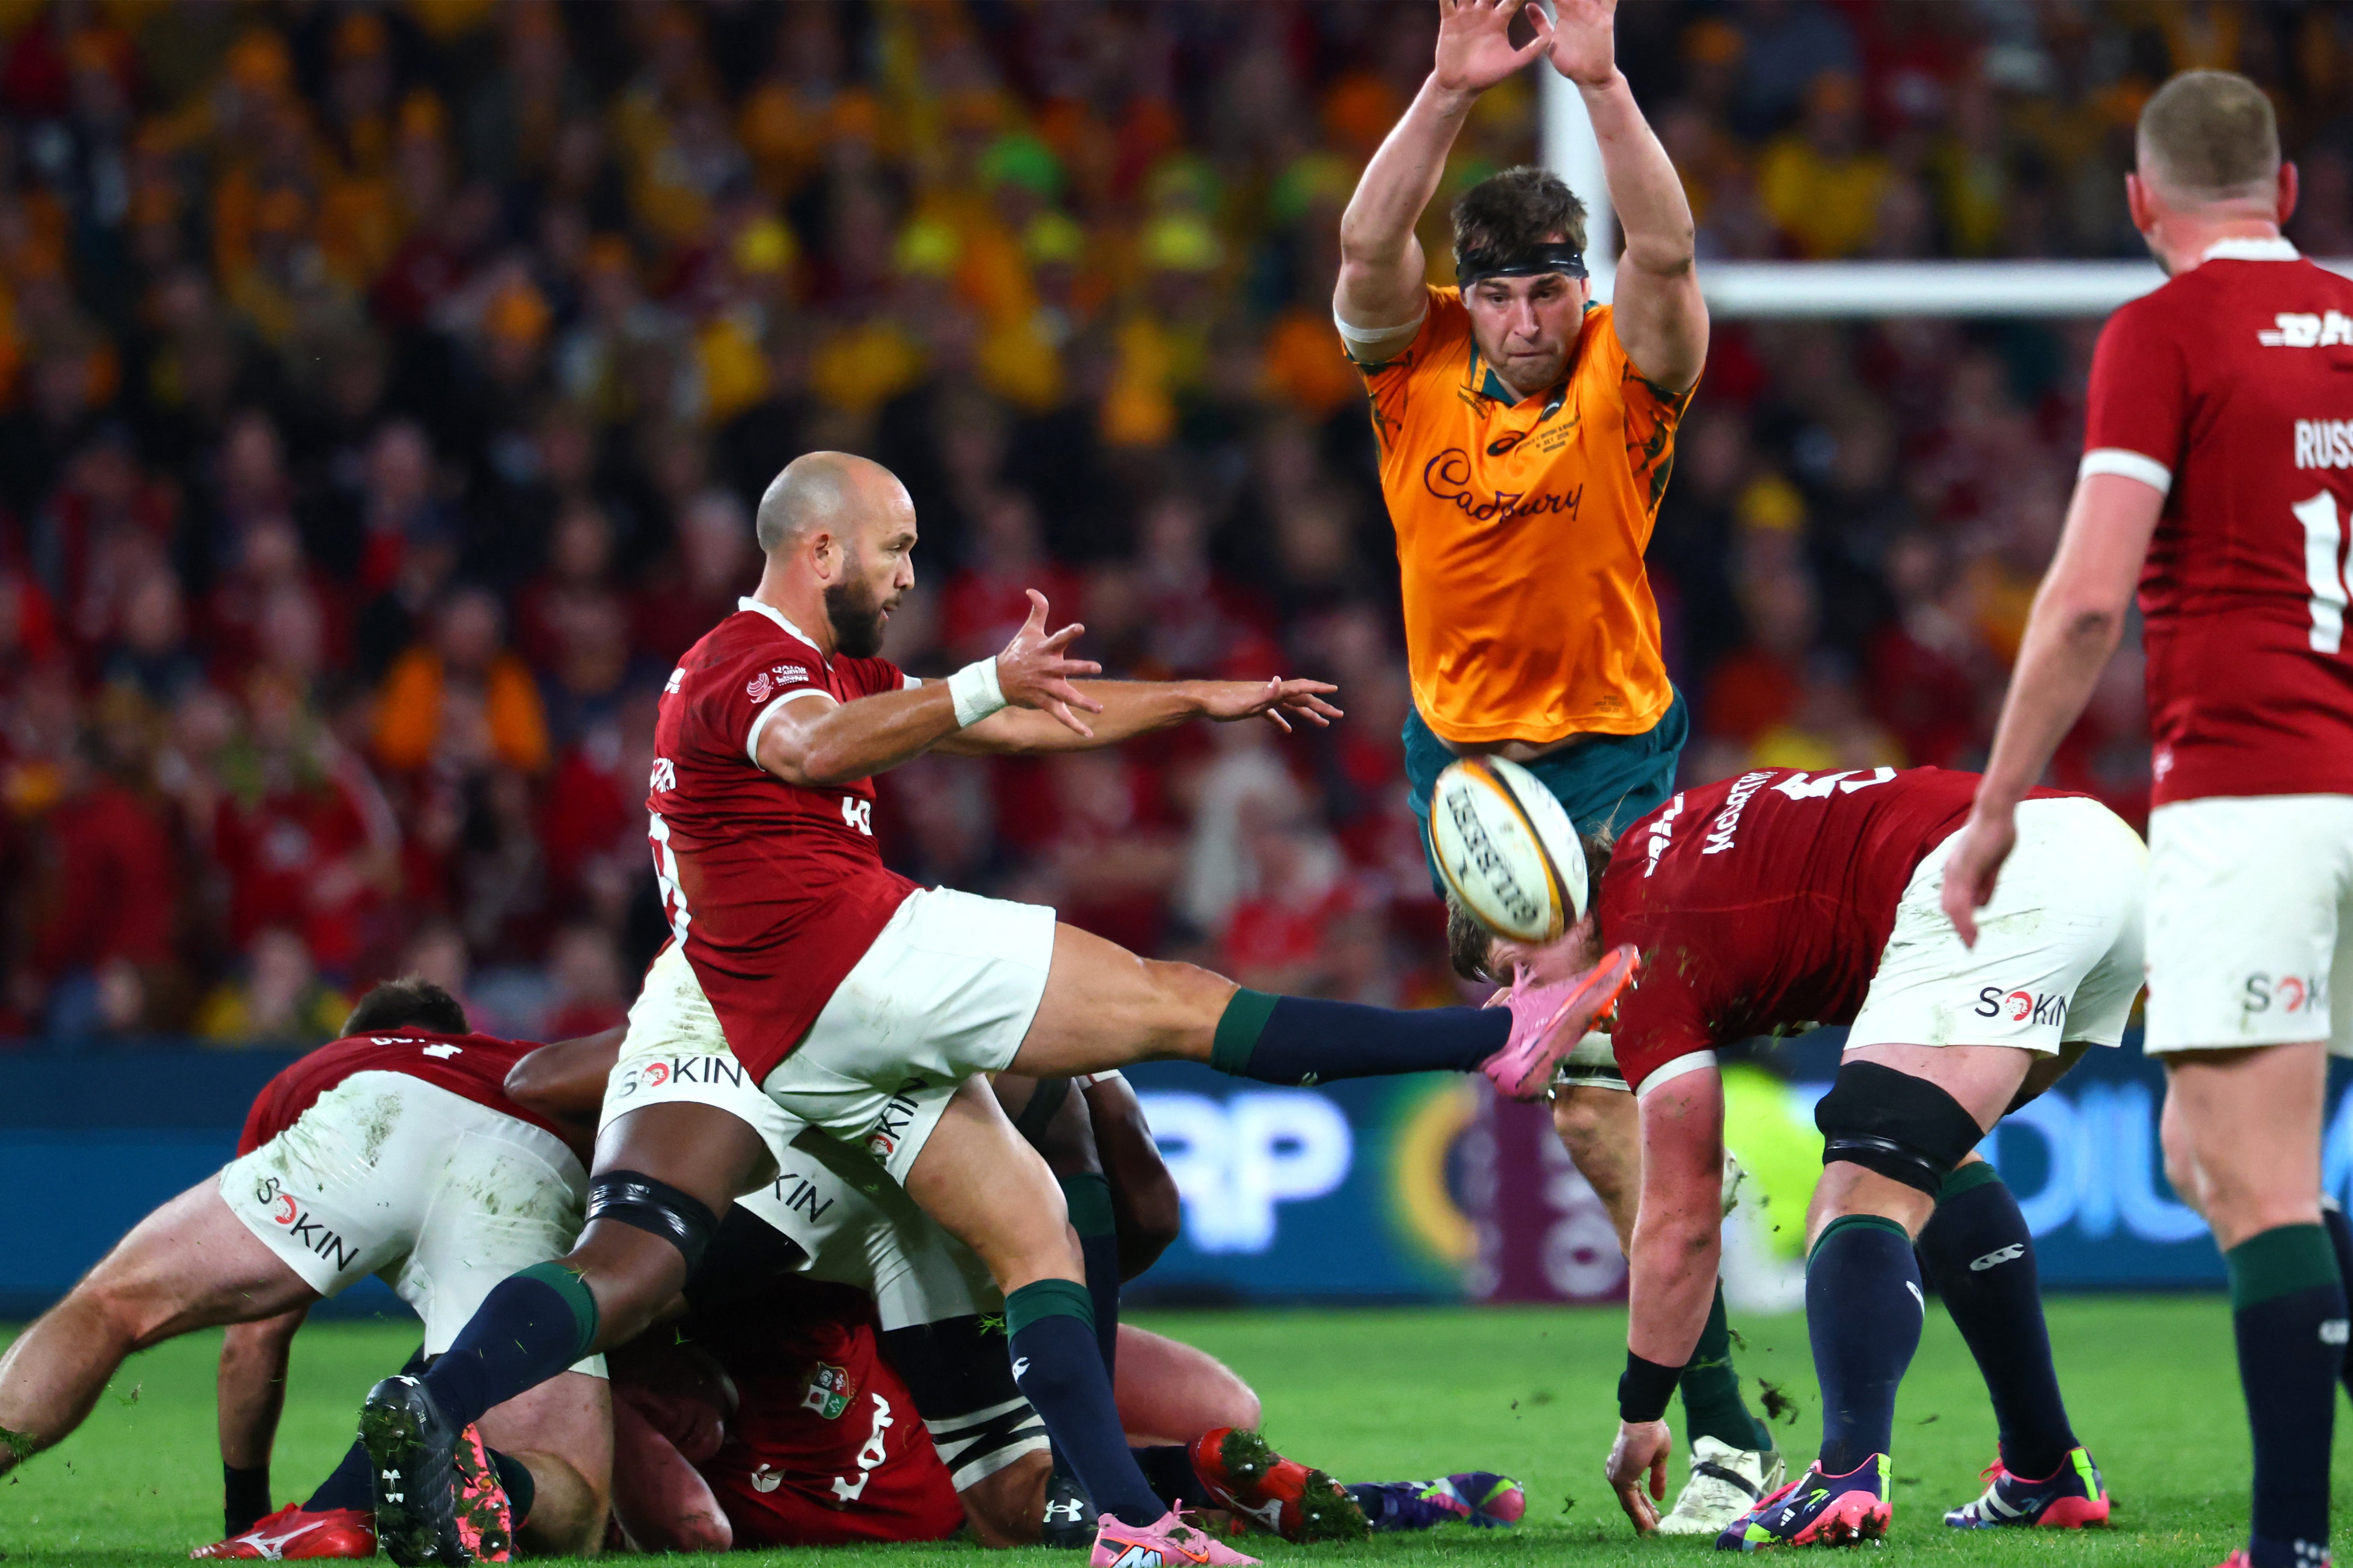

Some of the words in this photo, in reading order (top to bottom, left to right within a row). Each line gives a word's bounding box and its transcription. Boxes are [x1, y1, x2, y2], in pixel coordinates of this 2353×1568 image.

[2294, 419, 2353, 470] RUS
[2291, 488, 2353, 654] 1
[1446, 782, 1541, 926] GILBERT
[619, 1056, 743, 1098] SOKIN
[257, 1177, 360, 1272] SOKIN
